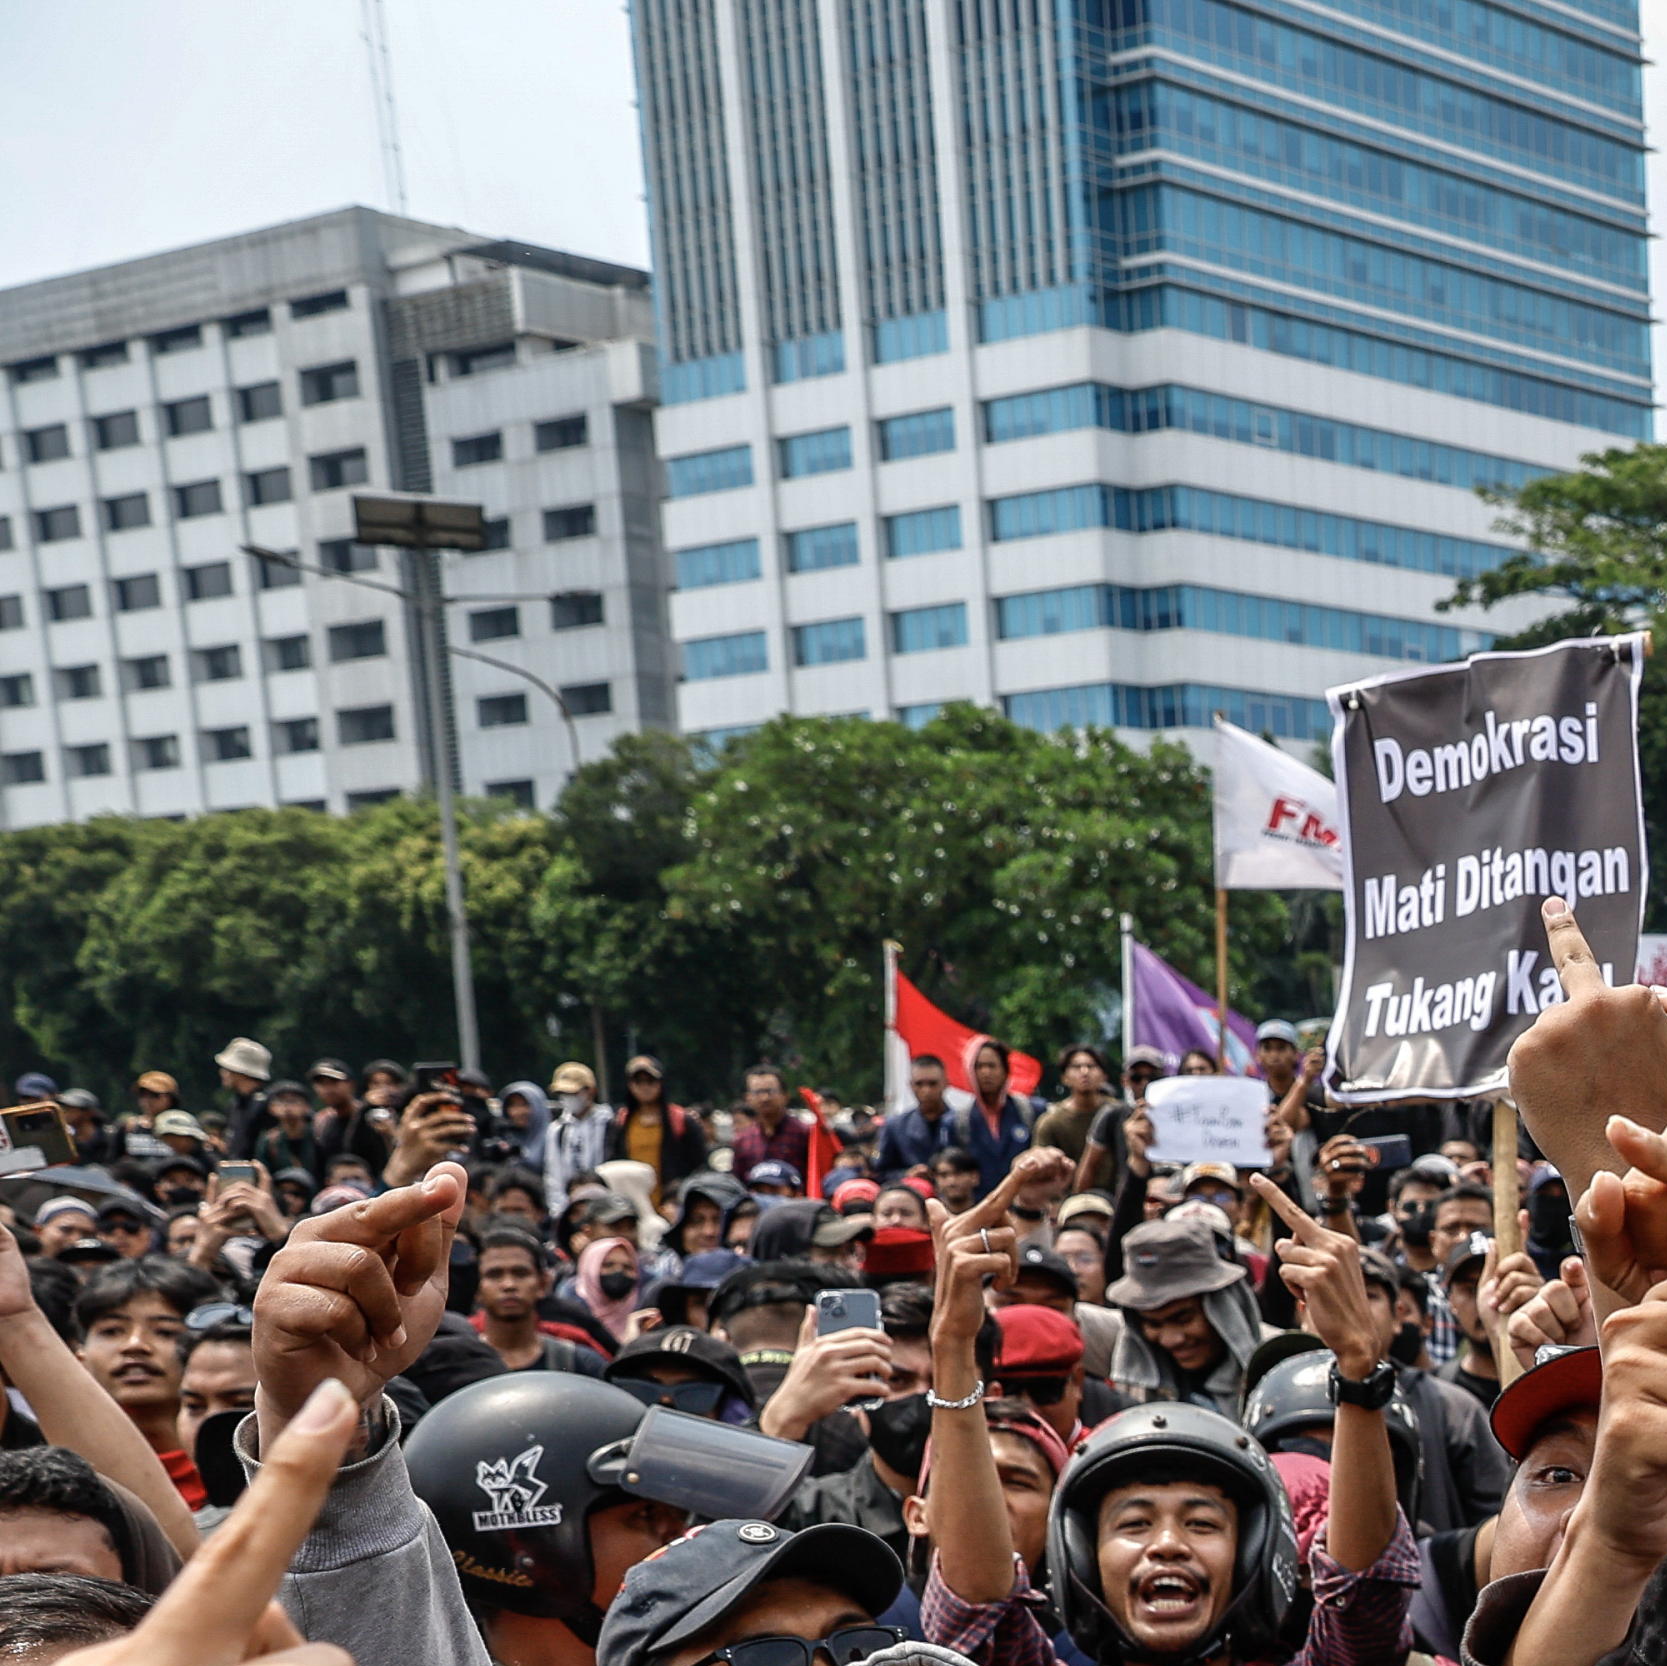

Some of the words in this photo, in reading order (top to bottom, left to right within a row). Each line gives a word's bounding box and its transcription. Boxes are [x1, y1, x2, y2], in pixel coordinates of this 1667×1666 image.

[1374, 702, 1599, 803] Demokrasi
[1364, 864, 1445, 939] Mati
[1456, 845, 1629, 917] Ditangan
[1364, 969, 1496, 1038] Tukang
